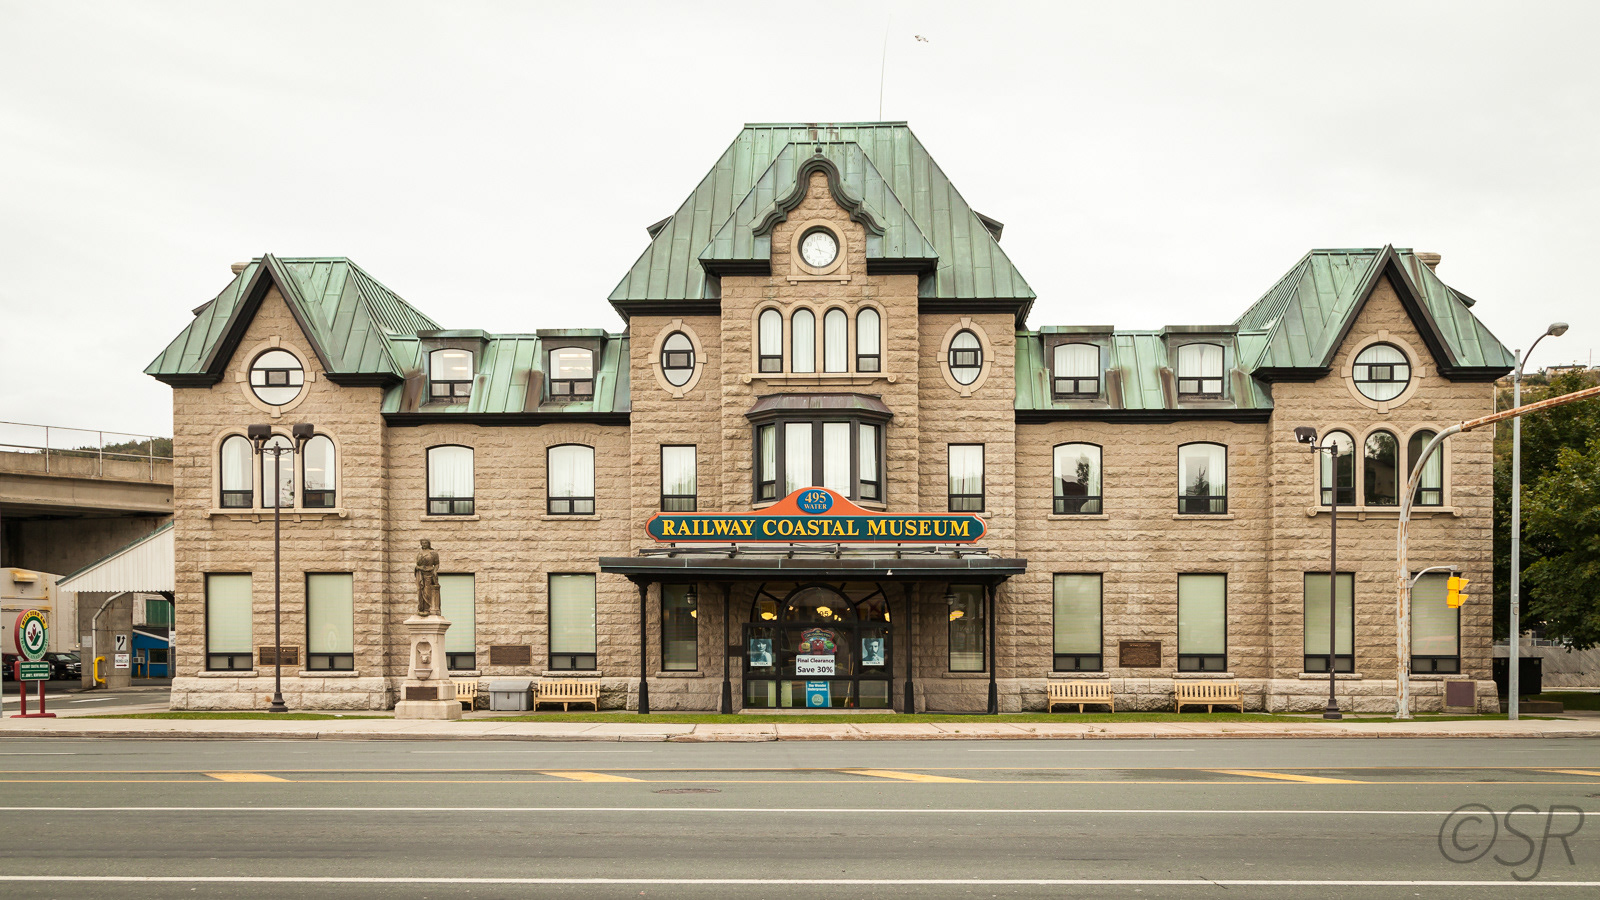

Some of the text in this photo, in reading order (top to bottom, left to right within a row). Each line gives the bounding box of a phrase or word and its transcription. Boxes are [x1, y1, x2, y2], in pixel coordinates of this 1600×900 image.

[804, 492, 826, 504] 495
[662, 520, 970, 536] RAILWAY COASTAL MUSEUM
